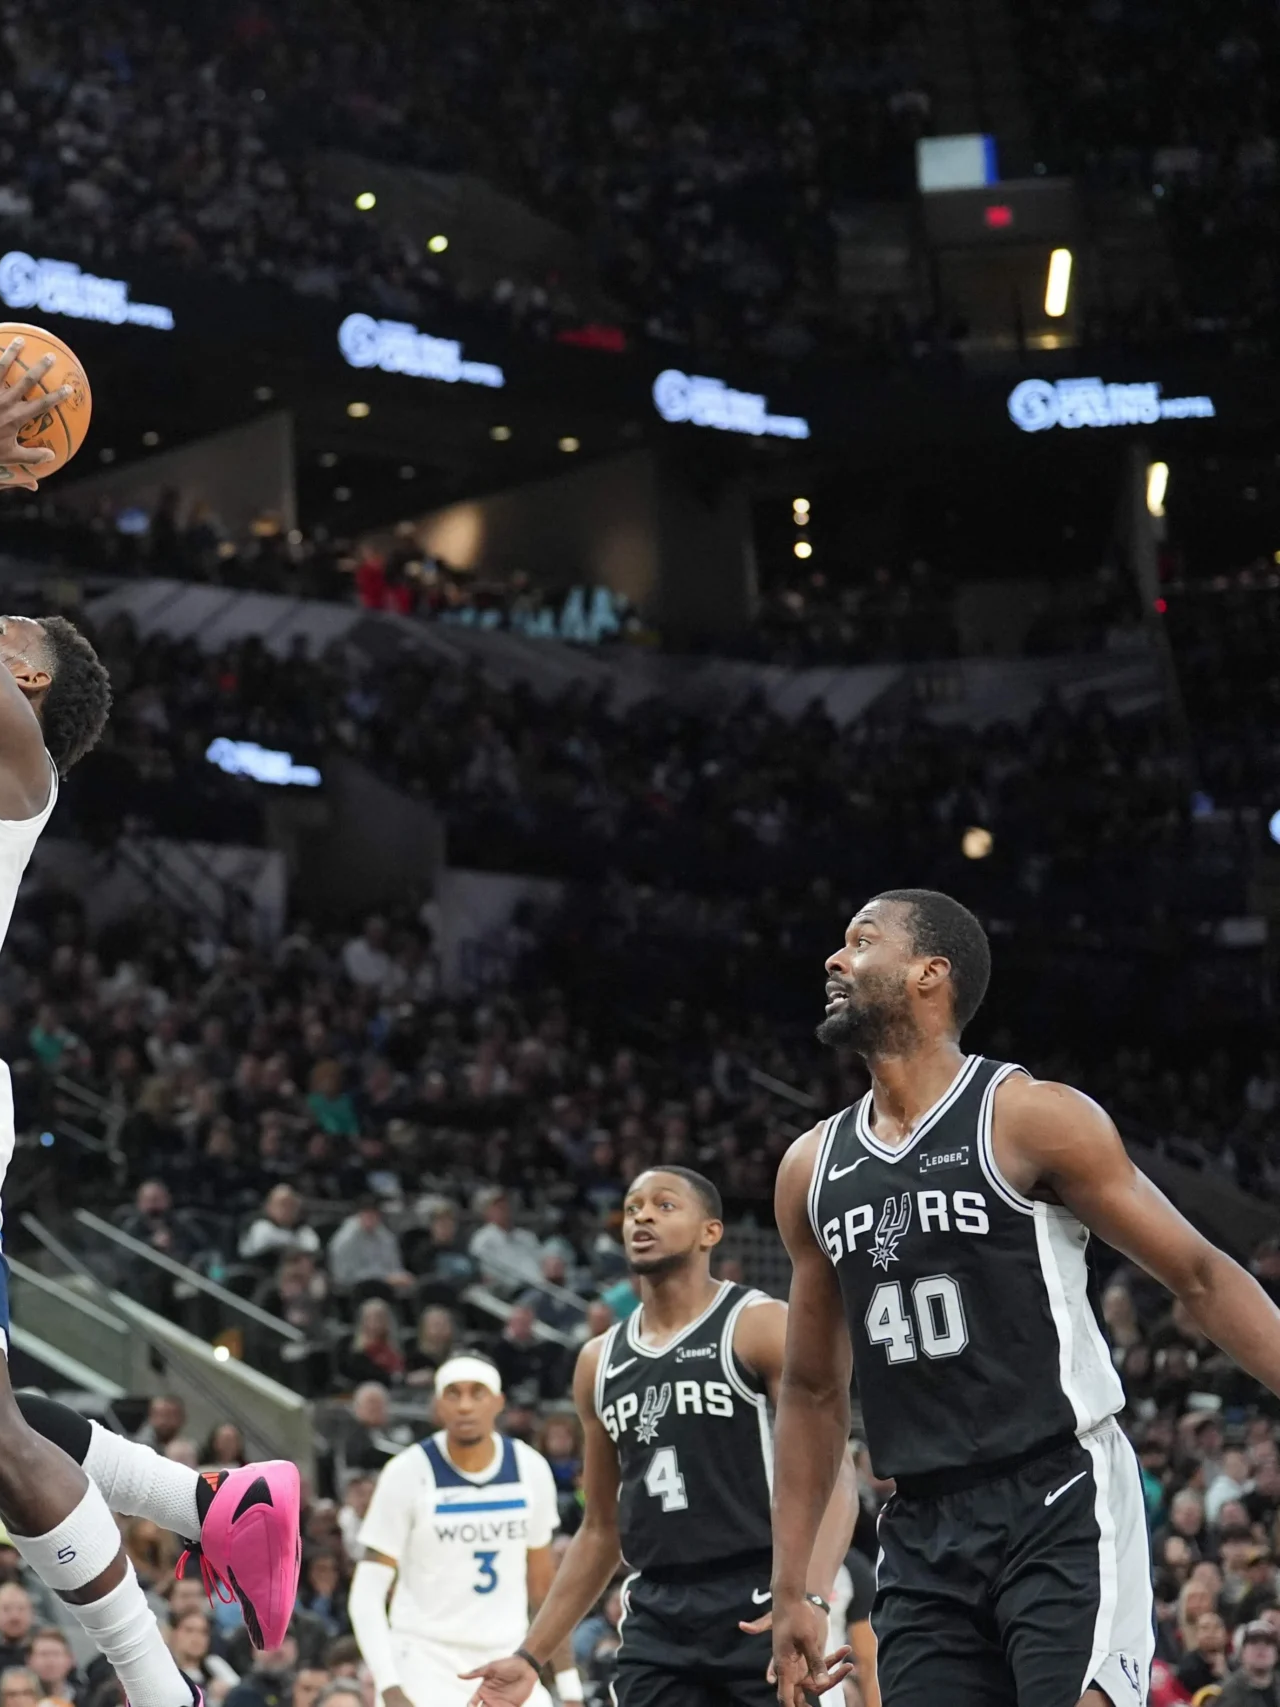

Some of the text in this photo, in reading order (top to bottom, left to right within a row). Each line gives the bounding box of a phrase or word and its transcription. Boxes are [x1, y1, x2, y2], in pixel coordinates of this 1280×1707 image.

[925, 1152, 963, 1167] LEDGER
[823, 1190, 990, 1272] SPURS
[864, 1273, 969, 1365] 40
[602, 1380, 734, 1445] SPURS
[644, 1445, 689, 1513] 4
[434, 1519, 527, 1543] WOLVES
[473, 1550, 500, 1594] 3
